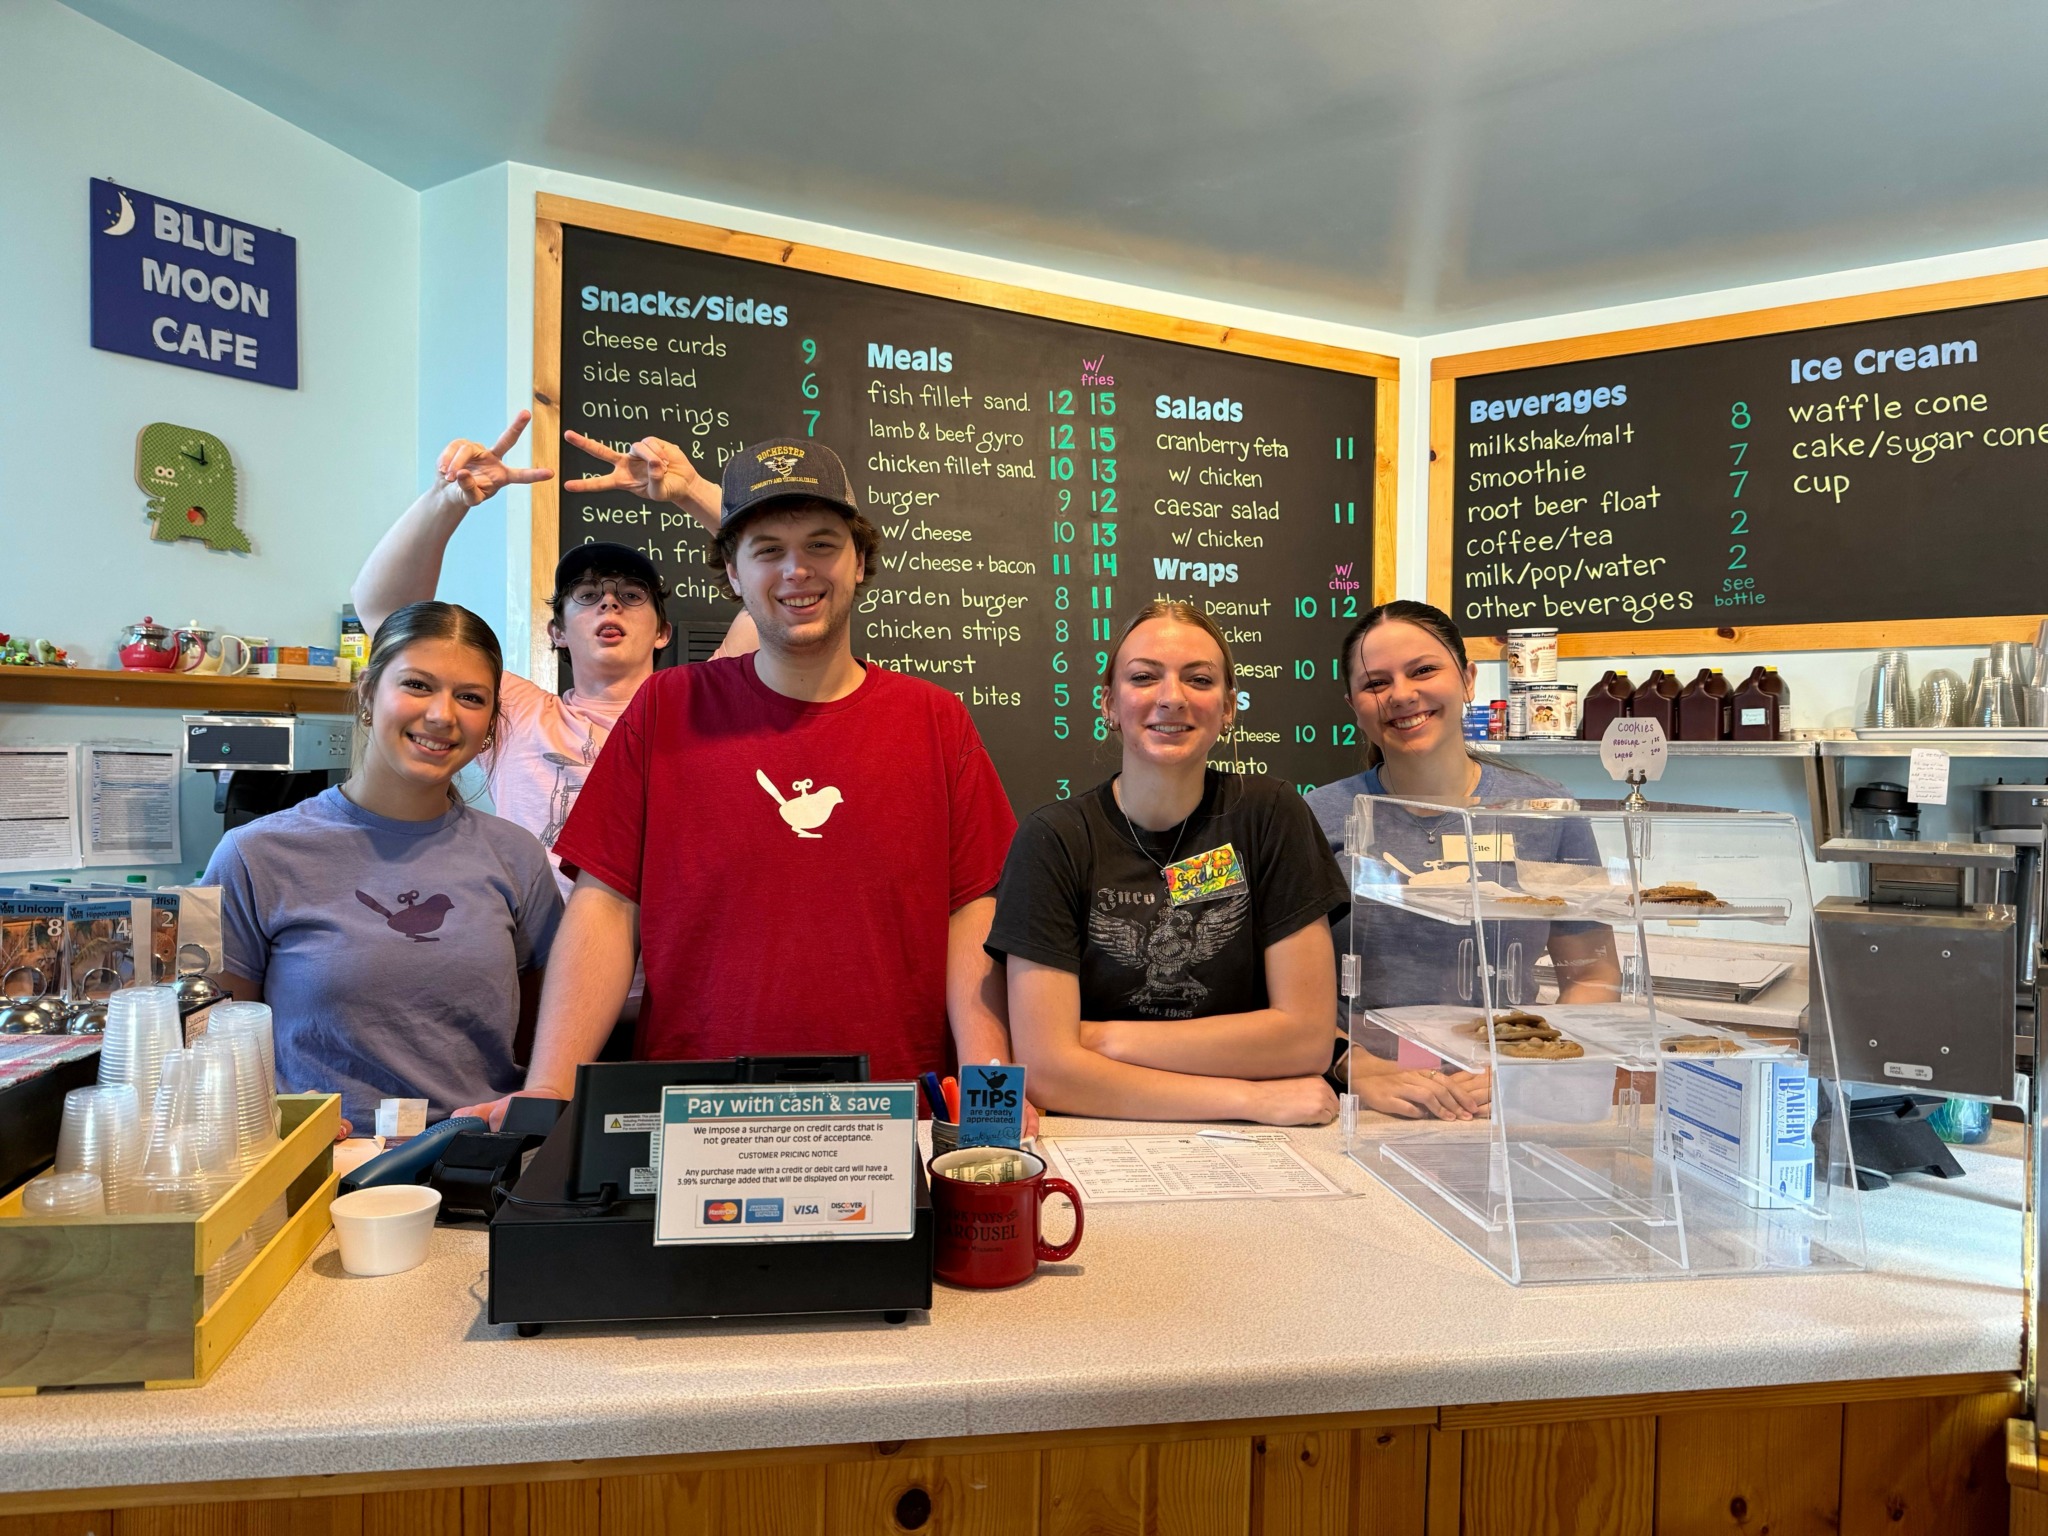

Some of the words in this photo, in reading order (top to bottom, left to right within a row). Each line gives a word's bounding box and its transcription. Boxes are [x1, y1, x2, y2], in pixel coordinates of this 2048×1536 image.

[154, 203, 255, 265] BLUE
[142, 257, 269, 318] MOON
[581, 285, 788, 327] Snacks/Sides
[152, 317, 258, 369] CAFE
[582, 326, 658, 351] cheese
[668, 335, 727, 357] curds
[802, 339, 817, 364] 9
[868, 343, 953, 373] Meals
[1083, 355, 1104, 373] w/
[1790, 356, 1843, 385] Ice
[1854, 339, 1978, 375] Cream
[583, 362, 630, 383] side
[639, 367, 697, 388] salad
[801, 373, 819, 399] 6
[1080, 373, 1114, 386] fries
[868, 380, 913, 405] fish
[919, 384, 973, 408] fillet
[984, 393, 1031, 412] sand.
[1049, 390, 1074, 415] 12
[1091, 392, 1116, 416] 15
[1155, 394, 1243, 423] Salads
[1470, 384, 1628, 424] Beverages
[1789, 392, 1902, 424] waffle
[1915, 393, 1988, 416] cone
[582, 399, 648, 420] onion
[661, 404, 729, 435] rings
[803, 410, 821, 437] 7
[1469, 423, 1635, 459] milkshake/malt
[1730, 401, 1751, 429] 8
[869, 419, 914, 439] lamb
[918, 422, 929, 440] &
[936, 423, 975, 443] beef
[976, 431, 1023, 454] gyro
[1050, 425, 1075, 450] 12
[1091, 427, 1116, 452] 15
[1156, 431, 1250, 462] cranberry
[1253, 436, 1288, 458] feta
[1336, 436, 1354, 460] 11
[1792, 430, 1974, 464] cake/sugar
[692, 441, 704, 459] &
[756, 446, 805, 463] ROCHESTER
[868, 452, 940, 474] chicken
[944, 456, 992, 476] fillet
[997, 460, 1036, 479] sand.
[1050, 456, 1074, 481] 10
[1092, 458, 1116, 484] 13
[1168, 466, 1191, 486] w/
[1199, 466, 1263, 488] chicken
[1469, 459, 1587, 492] smoothie
[1729, 443, 1749, 466] 7
[868, 485, 939, 515] burger
[1058, 489, 1071, 512] 9
[1092, 488, 1118, 513] 12
[1468, 496, 1522, 523] root
[1535, 494, 1588, 517] beer
[1600, 485, 1661, 514] float
[1729, 470, 1749, 498] 7
[1793, 474, 1850, 504] cup
[582, 505, 651, 525] sweet
[1154, 498, 1223, 519] caesar
[1231, 501, 1280, 521] salad
[1334, 502, 1355, 525] 11
[1054, 521, 1075, 543] 10
[1092, 522, 1117, 547] 13
[1171, 528, 1193, 547] w/
[1197, 529, 1264, 548] chicken
[1466, 526, 1613, 557] coffee/tea
[1730, 510, 1749, 535] 2
[988, 555, 1036, 574] bacon
[1053, 554, 1070, 575] 11
[1093, 553, 1117, 577] 14
[1153, 557, 1239, 588] Wraps
[1335, 562, 1353, 579] w/
[1466, 553, 1666, 590] milk/pop/water
[1728, 544, 1747, 570] 2
[1328, 579, 1360, 596] chips
[1722, 577, 1755, 592] see
[858, 586, 950, 613] garden
[961, 588, 1029, 617] burger
[1055, 586, 1070, 610] 8
[1091, 586, 1112, 609] 11
[1294, 597, 1317, 619] 10
[1331, 595, 1358, 619] 12
[1466, 595, 1536, 620] other
[1543, 590, 1694, 623] beverages
[1714, 591, 1766, 607] bottle
[866, 618, 951, 641] chicken
[962, 619, 1021, 647] strips
[1055, 619, 1069, 643] 8
[1092, 618, 1110, 641] 11
[1052, 651, 1068, 673] 6
[1095, 651, 1109, 675] 9
[1294, 659, 1316, 681] 10
[973, 686, 1021, 706] bites
[1054, 683, 1070, 707] 5
[1054, 716, 1070, 740] 5
[1093, 716, 1109, 741] 8
[1295, 724, 1316, 743] 10
[1332, 723, 1356, 746] 12
[1055, 779, 1071, 800] 3
[1177, 866, 1228, 890] Sadie
[18, 904, 63, 914] Unicorn
[86, 910, 129, 918] Hippocampus
[162, 911, 173, 927] 2
[48, 919, 62, 937] 8
[116, 919, 130, 936] 4
[688, 1098, 724, 1116] Pay
[730, 1096, 774, 1113] with
[780, 1096, 824, 1112] cash
[829, 1096, 842, 1112] &
[847, 1096, 891, 1111] save
[967, 1089, 1017, 1108] TIPS
[966, 1116, 1016, 1124] appreciated!
[985, 1109, 1013, 1118] greatly
[1778, 1077, 1805, 1146] BAKERY
[693, 1126, 706, 1135] We
[749, 1124, 791, 1134] surcharge
[807, 1123, 831, 1132] credit
[833, 1123, 855, 1132] cards
[857, 1123, 875, 1131] that
[703, 1136, 719, 1144] not
[720, 1136, 752, 1145] greater
[754, 1135, 774, 1143] than
[823, 1134, 873, 1142] acceptance.
[738, 1151, 778, 1159] CUSTOMER
[699, 1177, 737, 1185] surcharge
[804, 1174, 837, 1183] displayed
[700, 1168, 734, 1177] purchase
[708, 1208, 738, 1216] MasterCard
[794, 1205, 819, 1215] VISA
[973, 1212, 1003, 1223] TOYS
